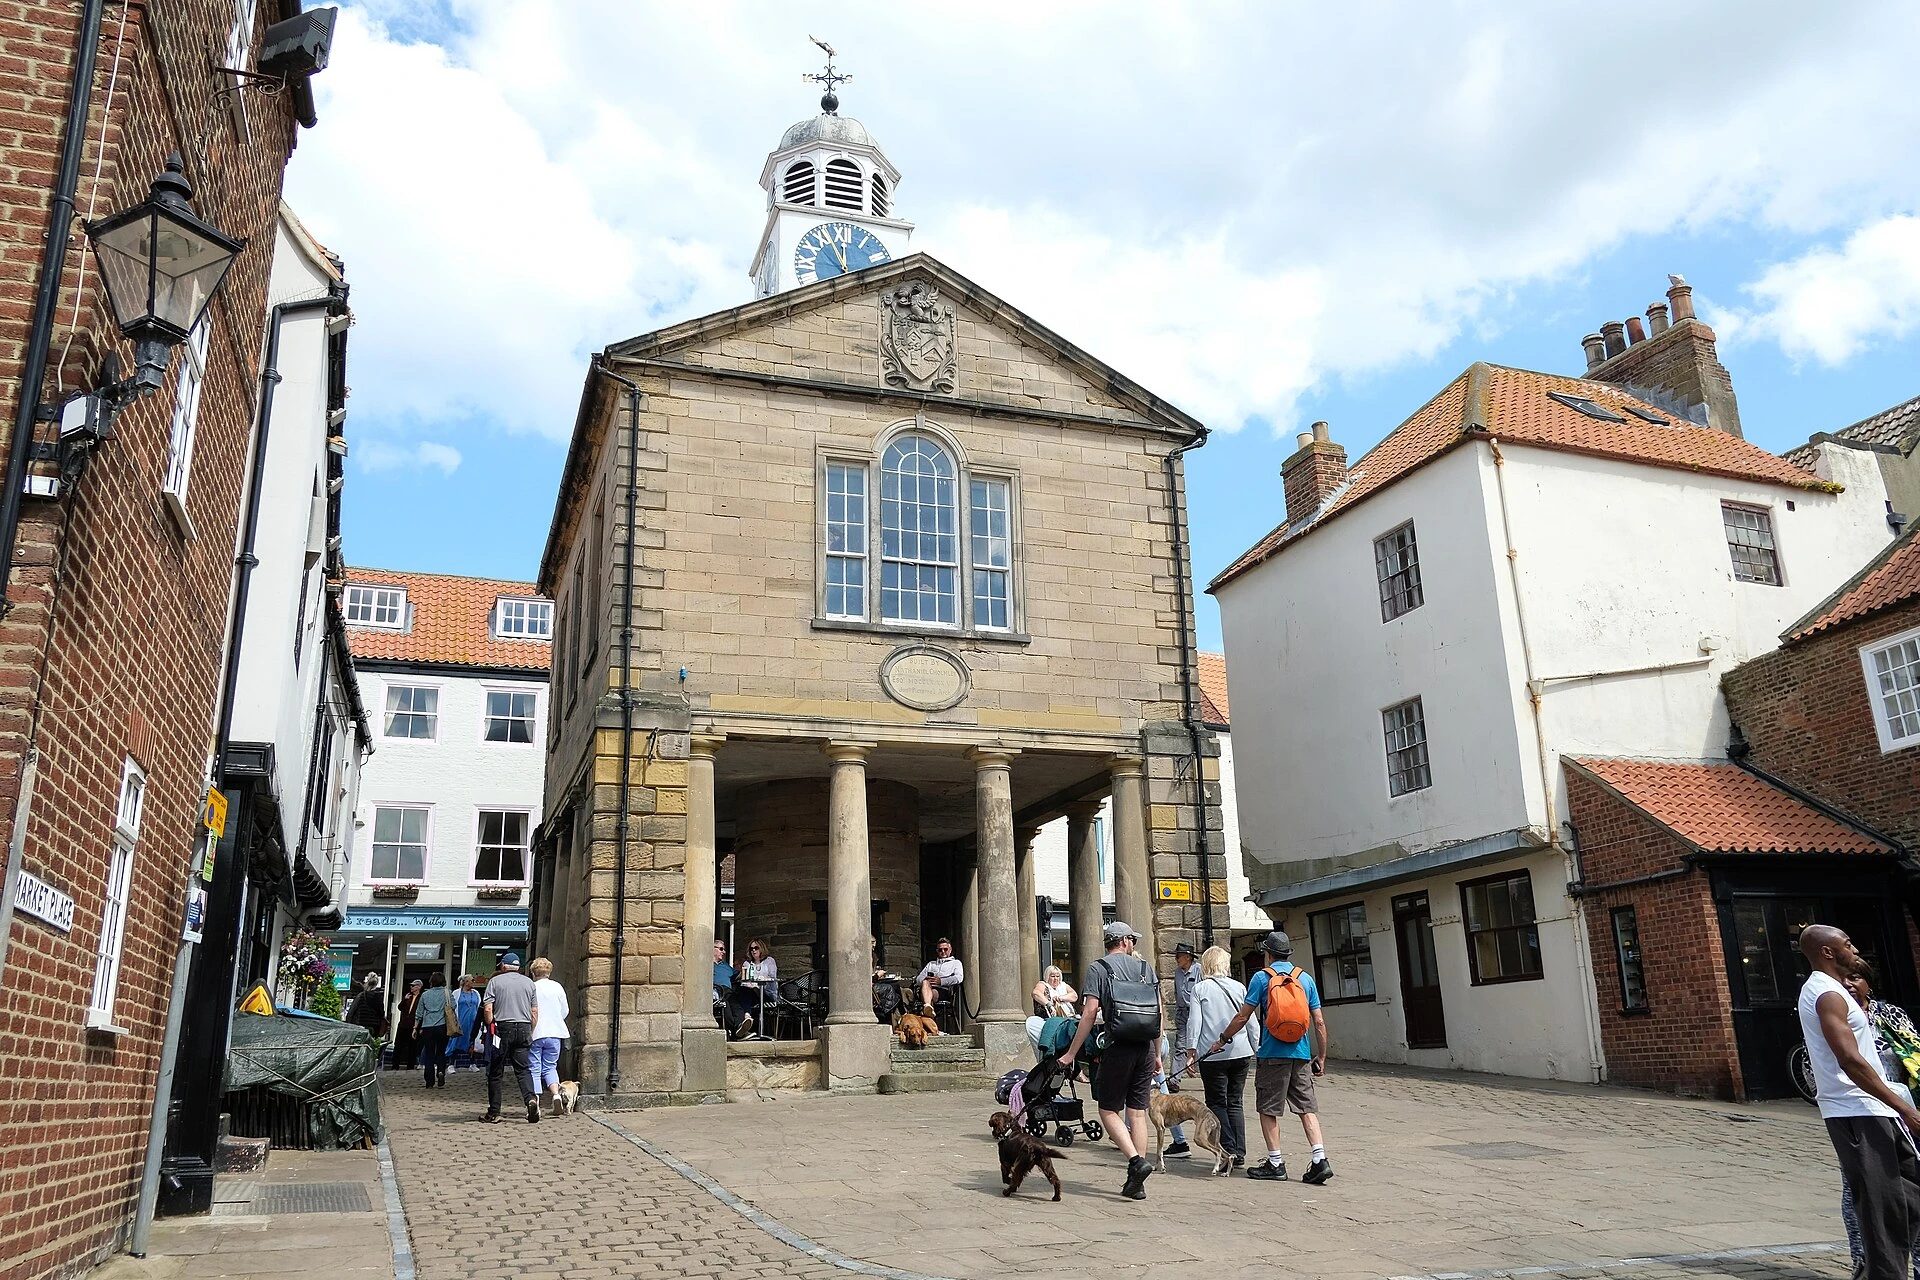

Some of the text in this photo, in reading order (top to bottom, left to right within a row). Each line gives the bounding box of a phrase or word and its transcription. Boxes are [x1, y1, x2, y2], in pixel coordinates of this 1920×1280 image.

[833, 226, 852, 244] XII
[48, 891, 73, 927] PLACE
[412, 915, 447, 929] Whitby
[468, 919, 502, 927] DISCOUNT
